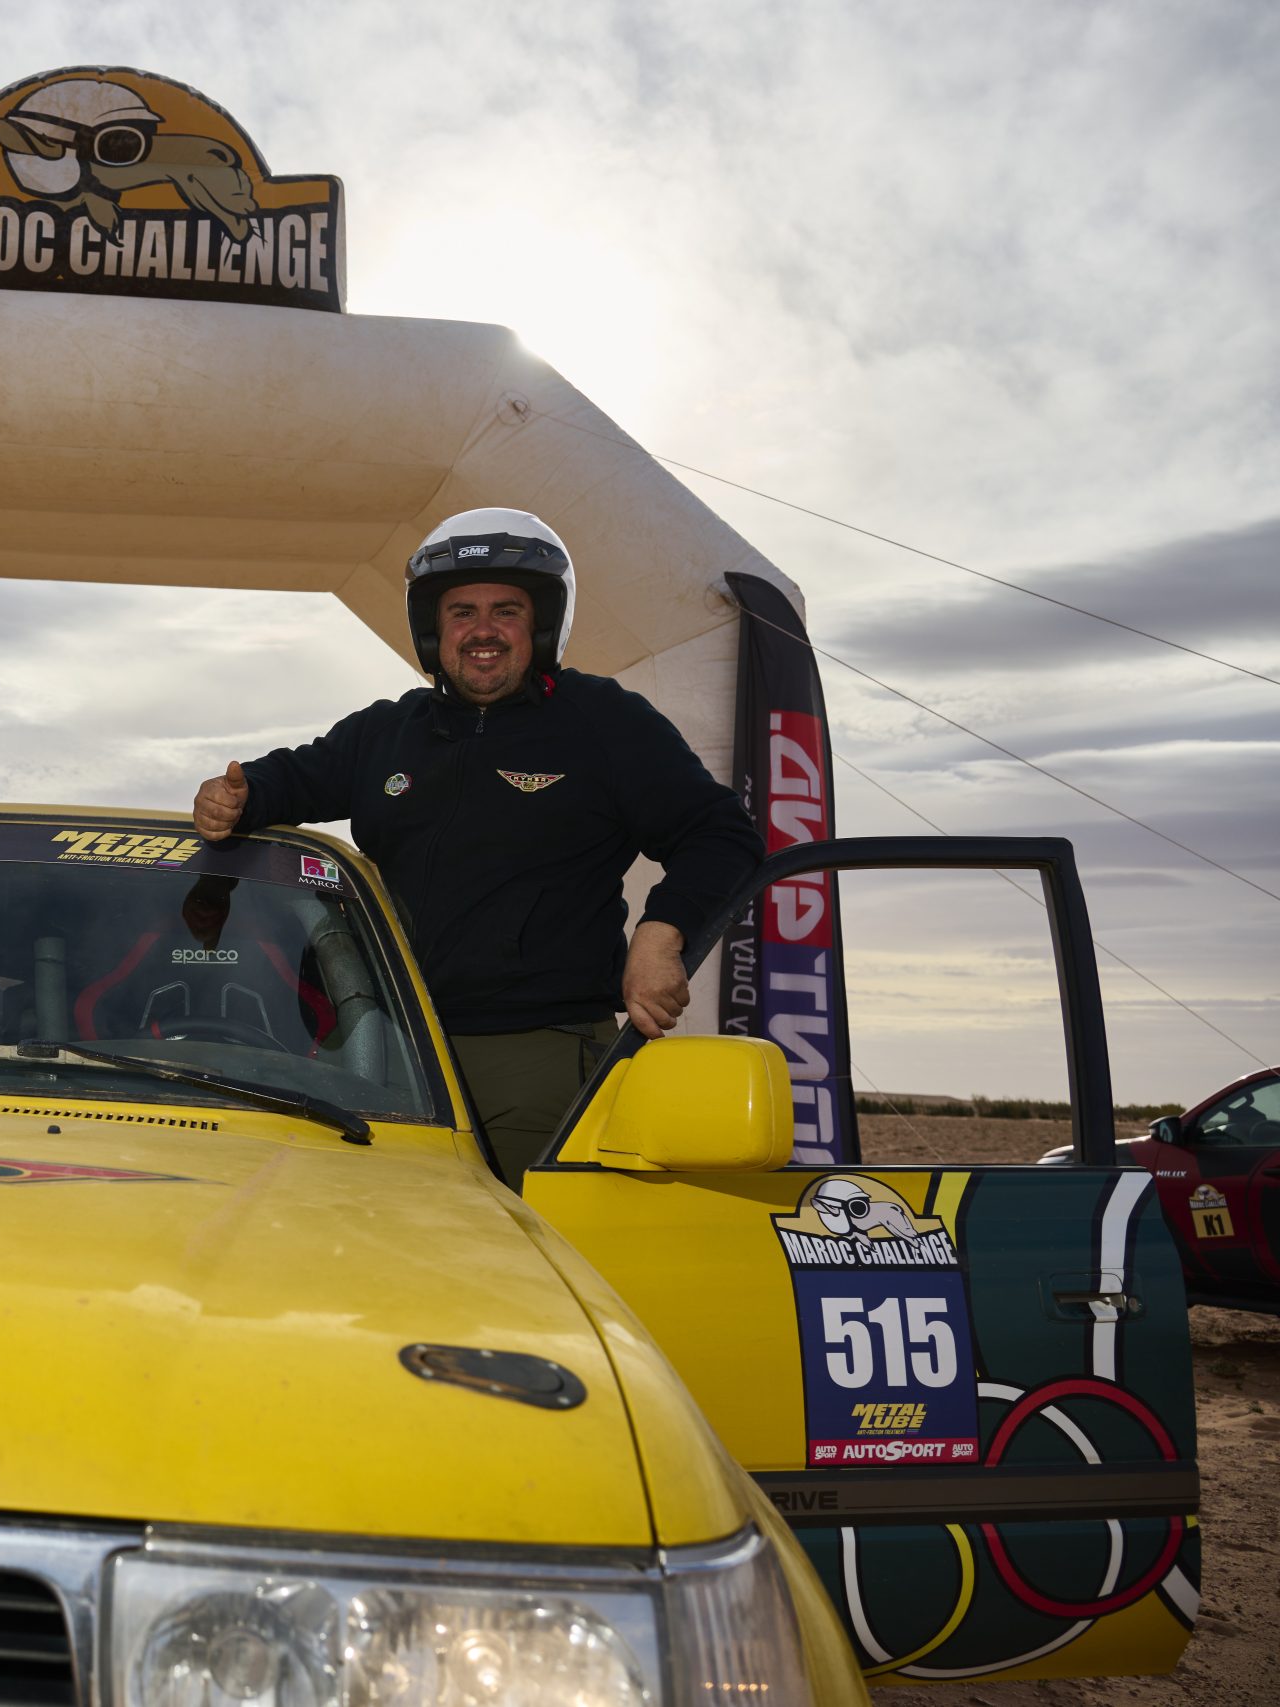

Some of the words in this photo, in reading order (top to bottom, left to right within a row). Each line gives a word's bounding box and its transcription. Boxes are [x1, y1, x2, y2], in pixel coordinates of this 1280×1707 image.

[69, 211, 329, 294] CHALLENGE
[458, 545, 490, 558] OMP
[51, 830, 201, 850] METAL
[57, 853, 110, 862] ANTI-FRICTION
[111, 856, 158, 865] TREATMENT
[64, 843, 202, 862] LUBE
[298, 876, 344, 890] MAROC
[171, 949, 239, 964] sparco
[1203, 1214, 1225, 1236] K1
[780, 1230, 856, 1264] MAROC
[856, 1231, 958, 1265] CHALLENGE
[821, 1297, 958, 1389] 515
[851, 1403, 927, 1418] METAL
[859, 1414, 926, 1429] LUBE
[815, 1445, 838, 1453] AUTO
[842, 1440, 946, 1461] AUTOSPORT
[951, 1450, 973, 1458] SPORT
[953, 1443, 973, 1451] AUTO
[814, 1452, 837, 1460] SPORT
